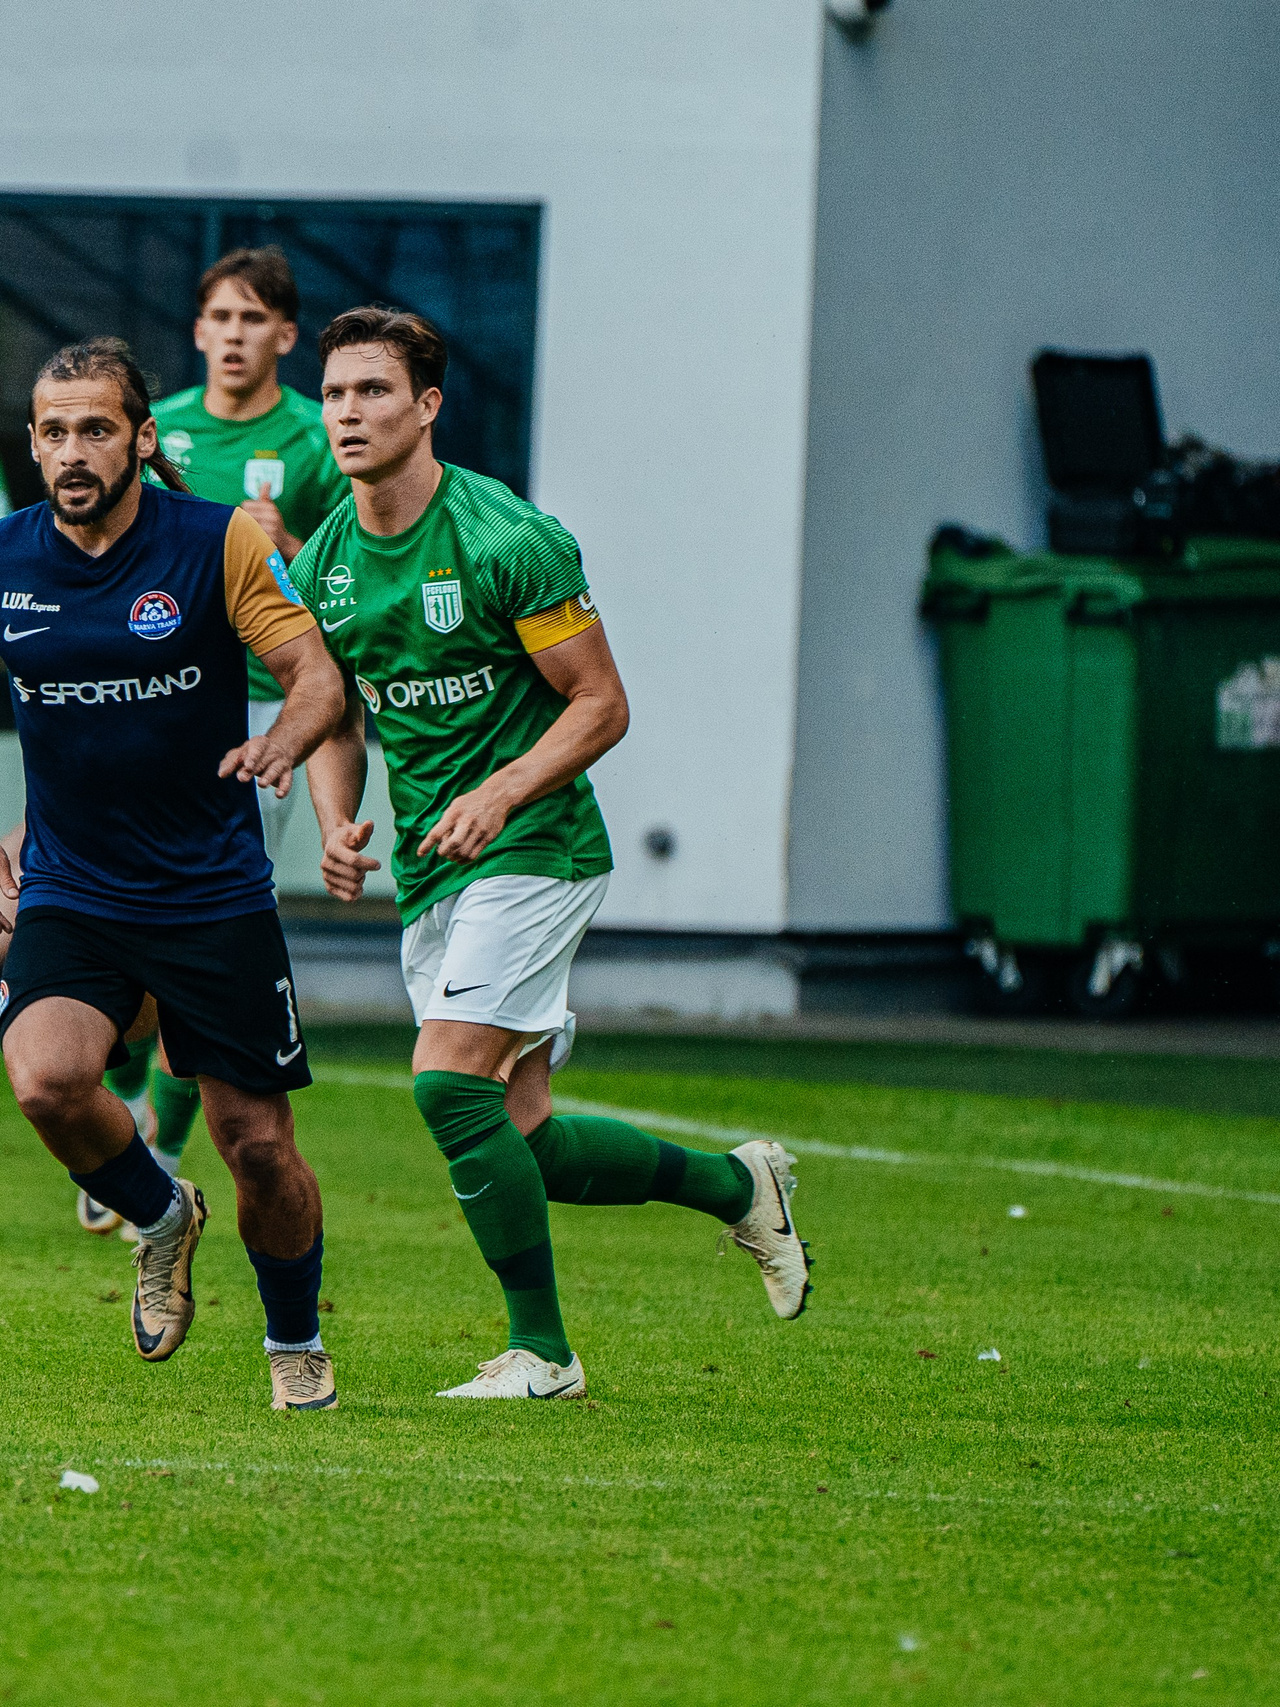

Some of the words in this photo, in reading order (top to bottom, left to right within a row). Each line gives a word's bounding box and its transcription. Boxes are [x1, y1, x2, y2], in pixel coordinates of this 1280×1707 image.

[1, 591, 34, 610] LUX
[30, 601, 61, 613] Express
[319, 597, 357, 610] OPEL
[133, 623, 156, 631] NARVA
[157, 619, 177, 629] TRANS
[39, 666, 202, 705] SPORTLAND
[386, 665, 495, 708] OPTIBET
[276, 977, 298, 1043] 7
